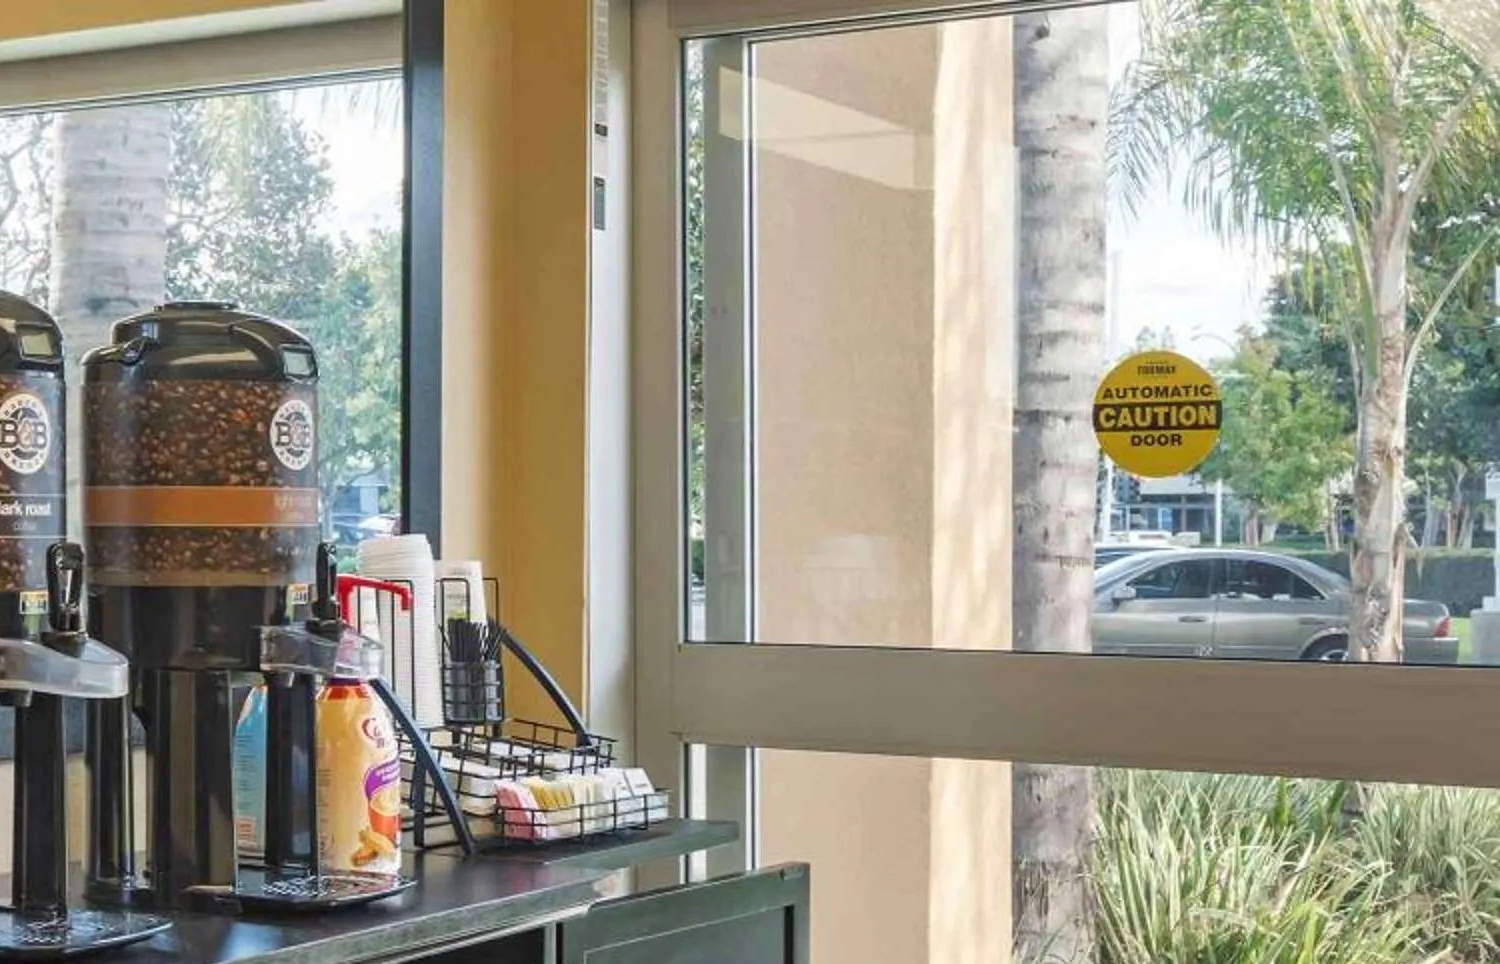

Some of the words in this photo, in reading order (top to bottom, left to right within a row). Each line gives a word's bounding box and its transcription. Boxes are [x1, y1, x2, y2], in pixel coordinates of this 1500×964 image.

[1102, 384, 1213, 399] AUTOMATIC
[1100, 405, 1217, 428] CAUTION
[1131, 433, 1183, 447] DOOR
[25, 501, 52, 516] roast
